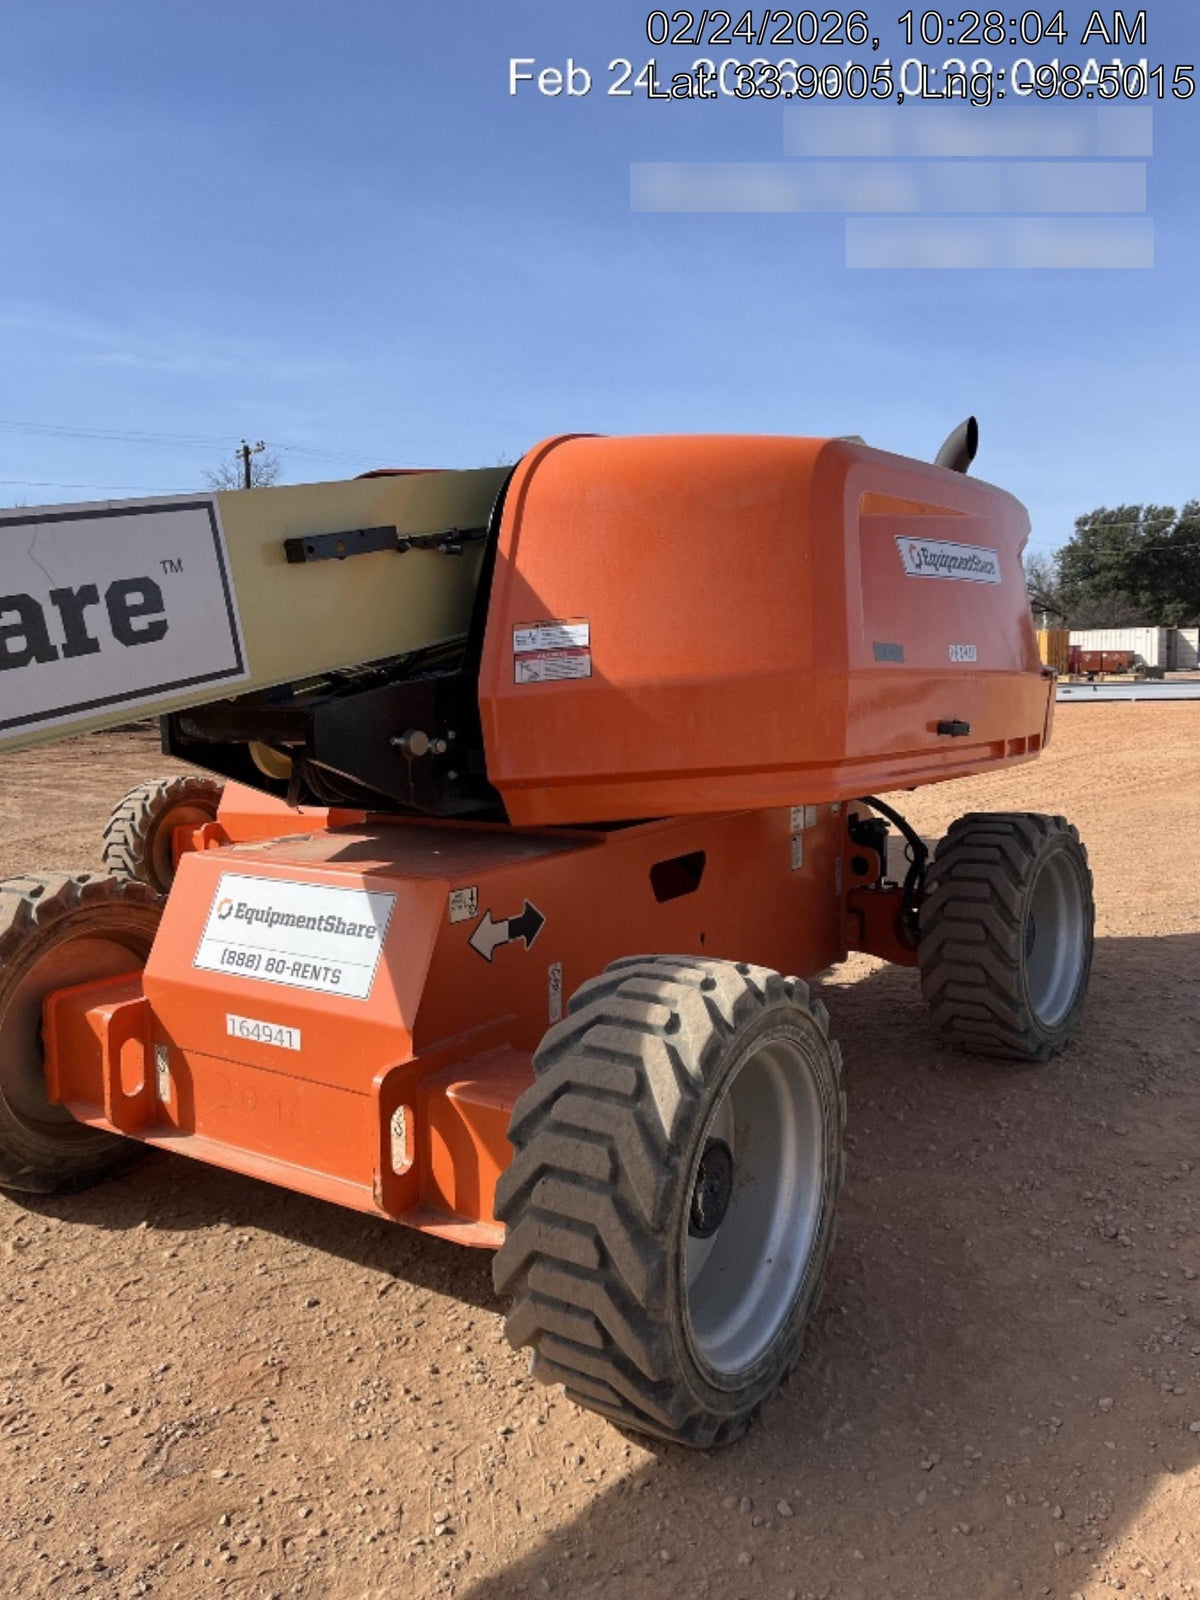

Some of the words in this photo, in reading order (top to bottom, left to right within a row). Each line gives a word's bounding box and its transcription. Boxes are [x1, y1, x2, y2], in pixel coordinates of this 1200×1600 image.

[234, 902, 378, 940] EquipmentShare
[220, 948, 262, 971] (888)
[264, 957, 343, 985] 80-RENTS
[228, 1017, 296, 1048] 164941
